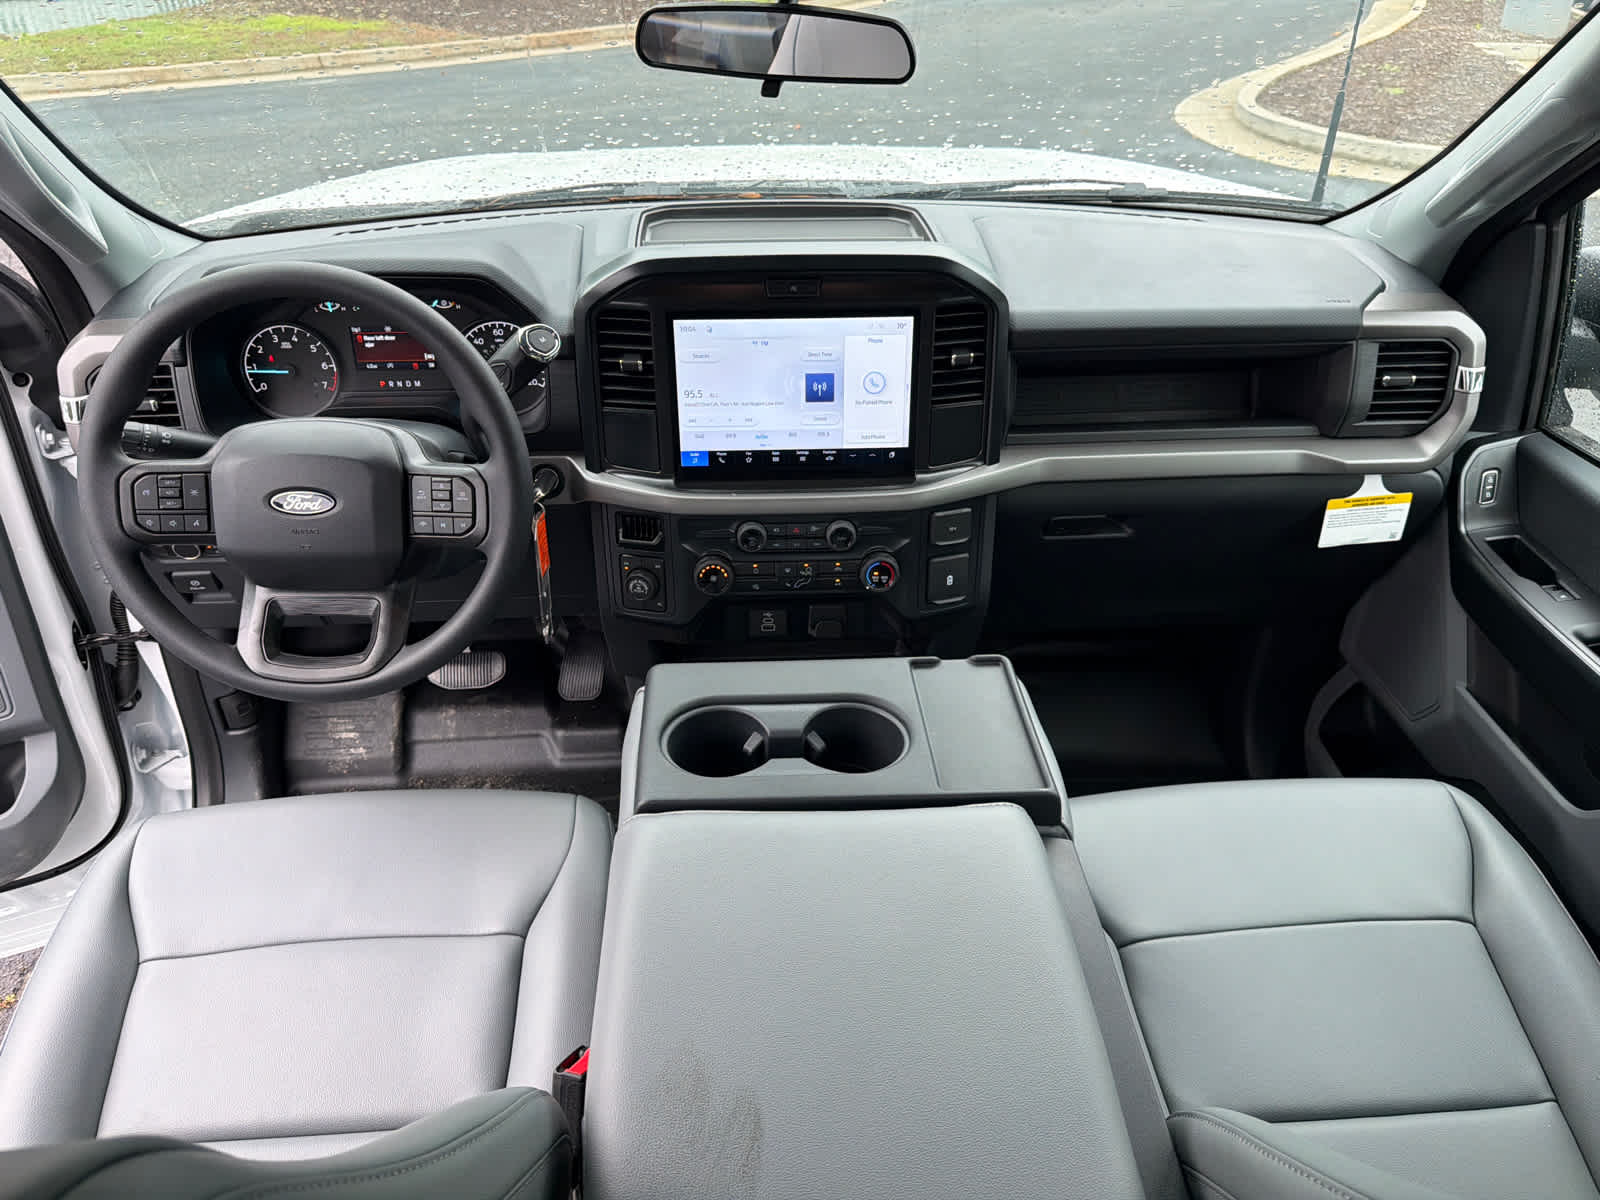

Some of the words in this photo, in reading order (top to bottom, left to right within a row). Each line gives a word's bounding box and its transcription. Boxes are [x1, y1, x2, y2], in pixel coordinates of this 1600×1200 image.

[493, 328, 504, 336] 60
[272, 334, 279, 343] 3
[291, 334, 298, 342] 4
[257, 345, 264, 353] 2
[310, 344, 317, 353] 5
[321, 361, 328, 370] 6
[260, 382, 268, 391] 0
[321, 381, 328, 389] 7
[379, 380, 386, 388] P
[683, 389, 703, 399] 95.5
[283, 494, 322, 511] Ford
